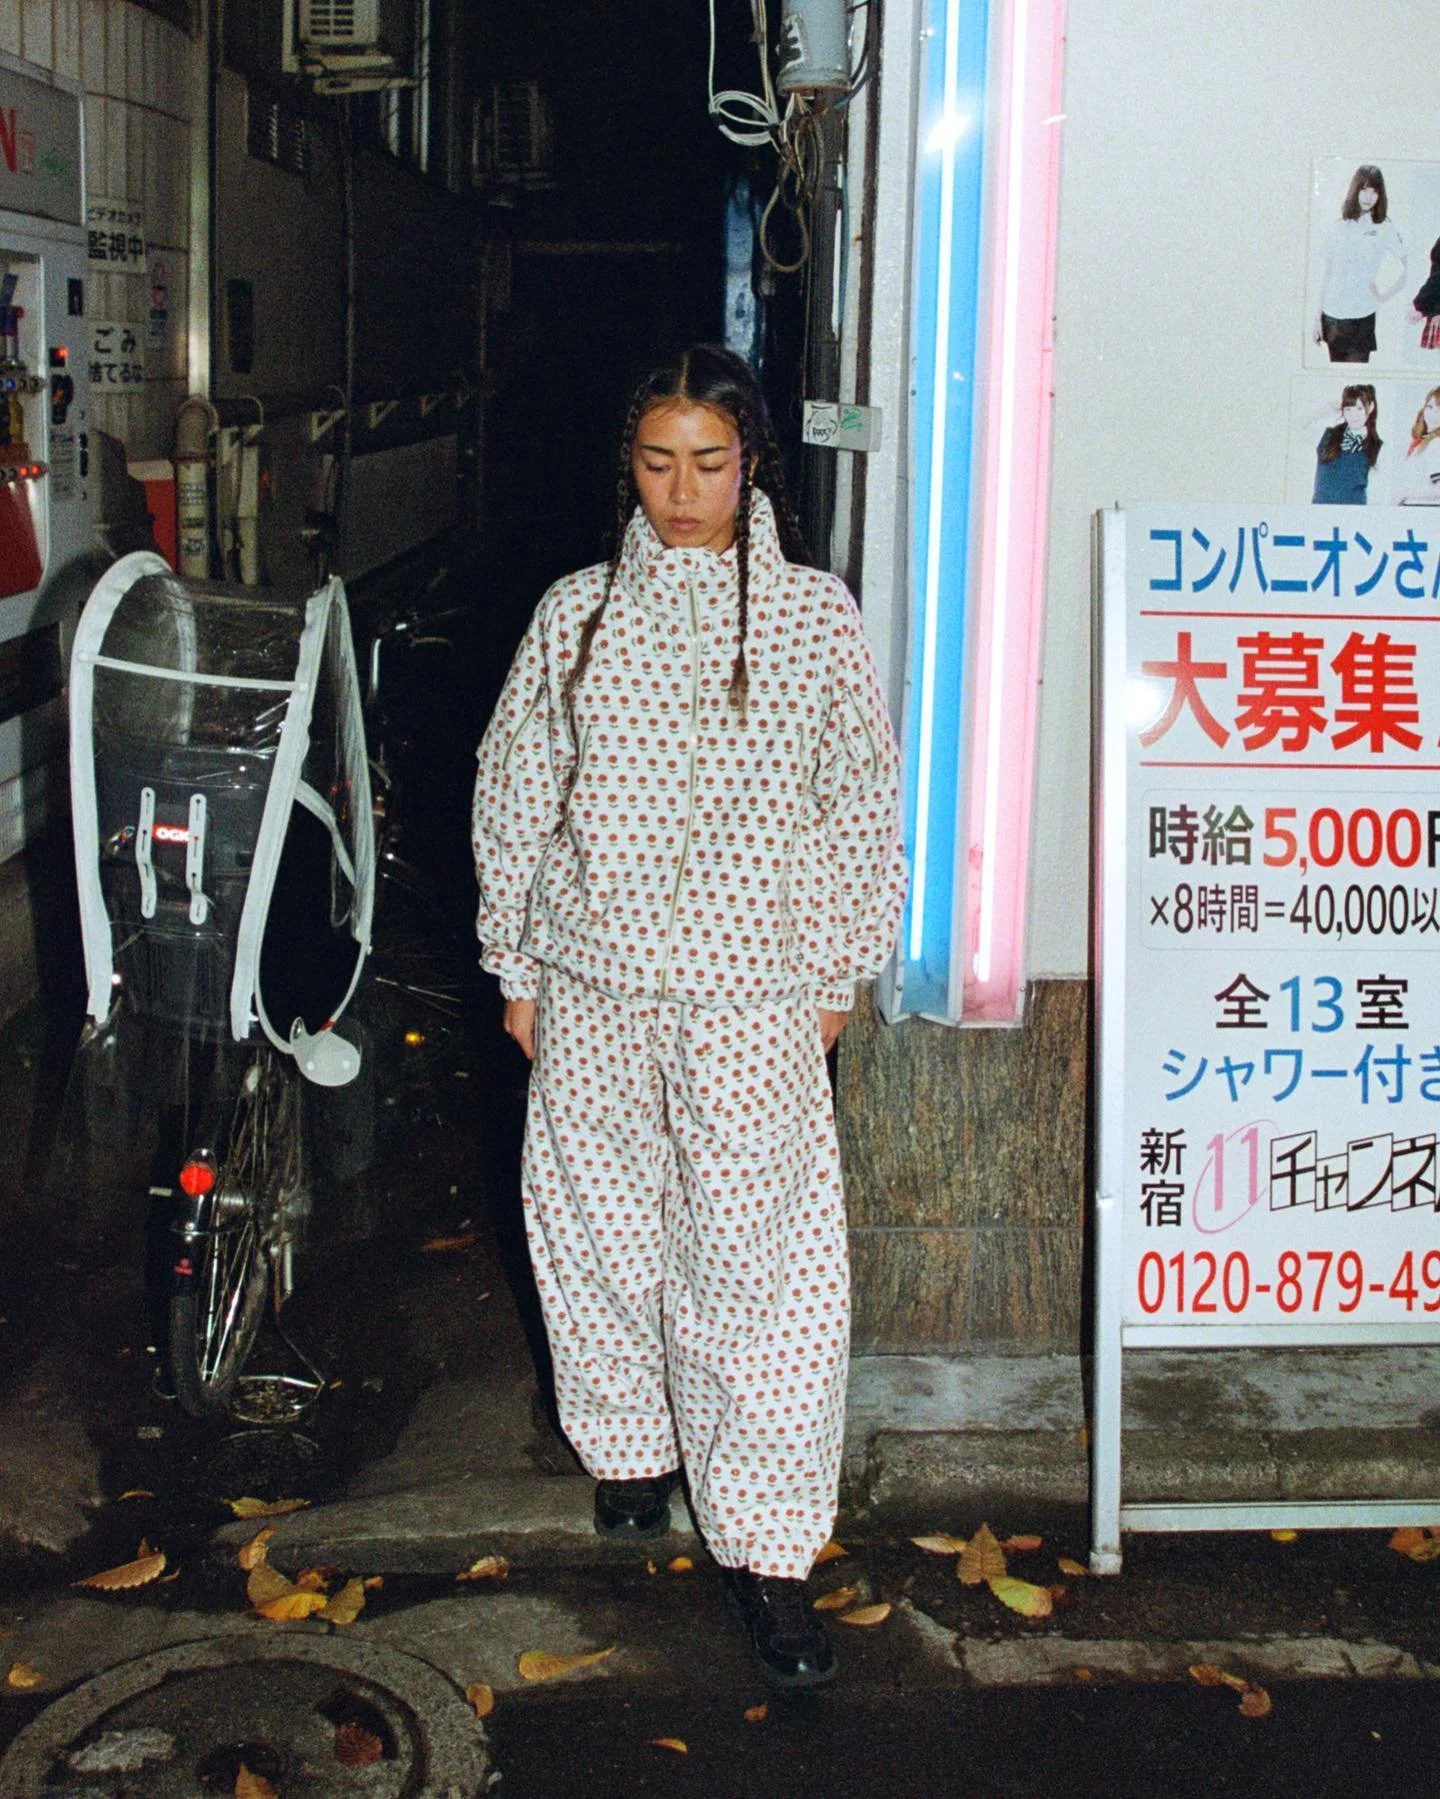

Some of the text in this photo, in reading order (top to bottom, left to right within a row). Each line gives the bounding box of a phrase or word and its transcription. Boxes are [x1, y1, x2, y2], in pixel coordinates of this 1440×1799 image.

[88, 230, 143, 264] 監視中
[88, 361, 143, 384] 捨てるな
[94, 328, 137, 354] ごみ
[1149, 522, 1440, 599] コンパニオンさ
[1139, 631, 1440, 753] 大募集
[1149, 804, 1440, 875] 時給5,000
[1139, 1127, 1188, 1227] 新宿
